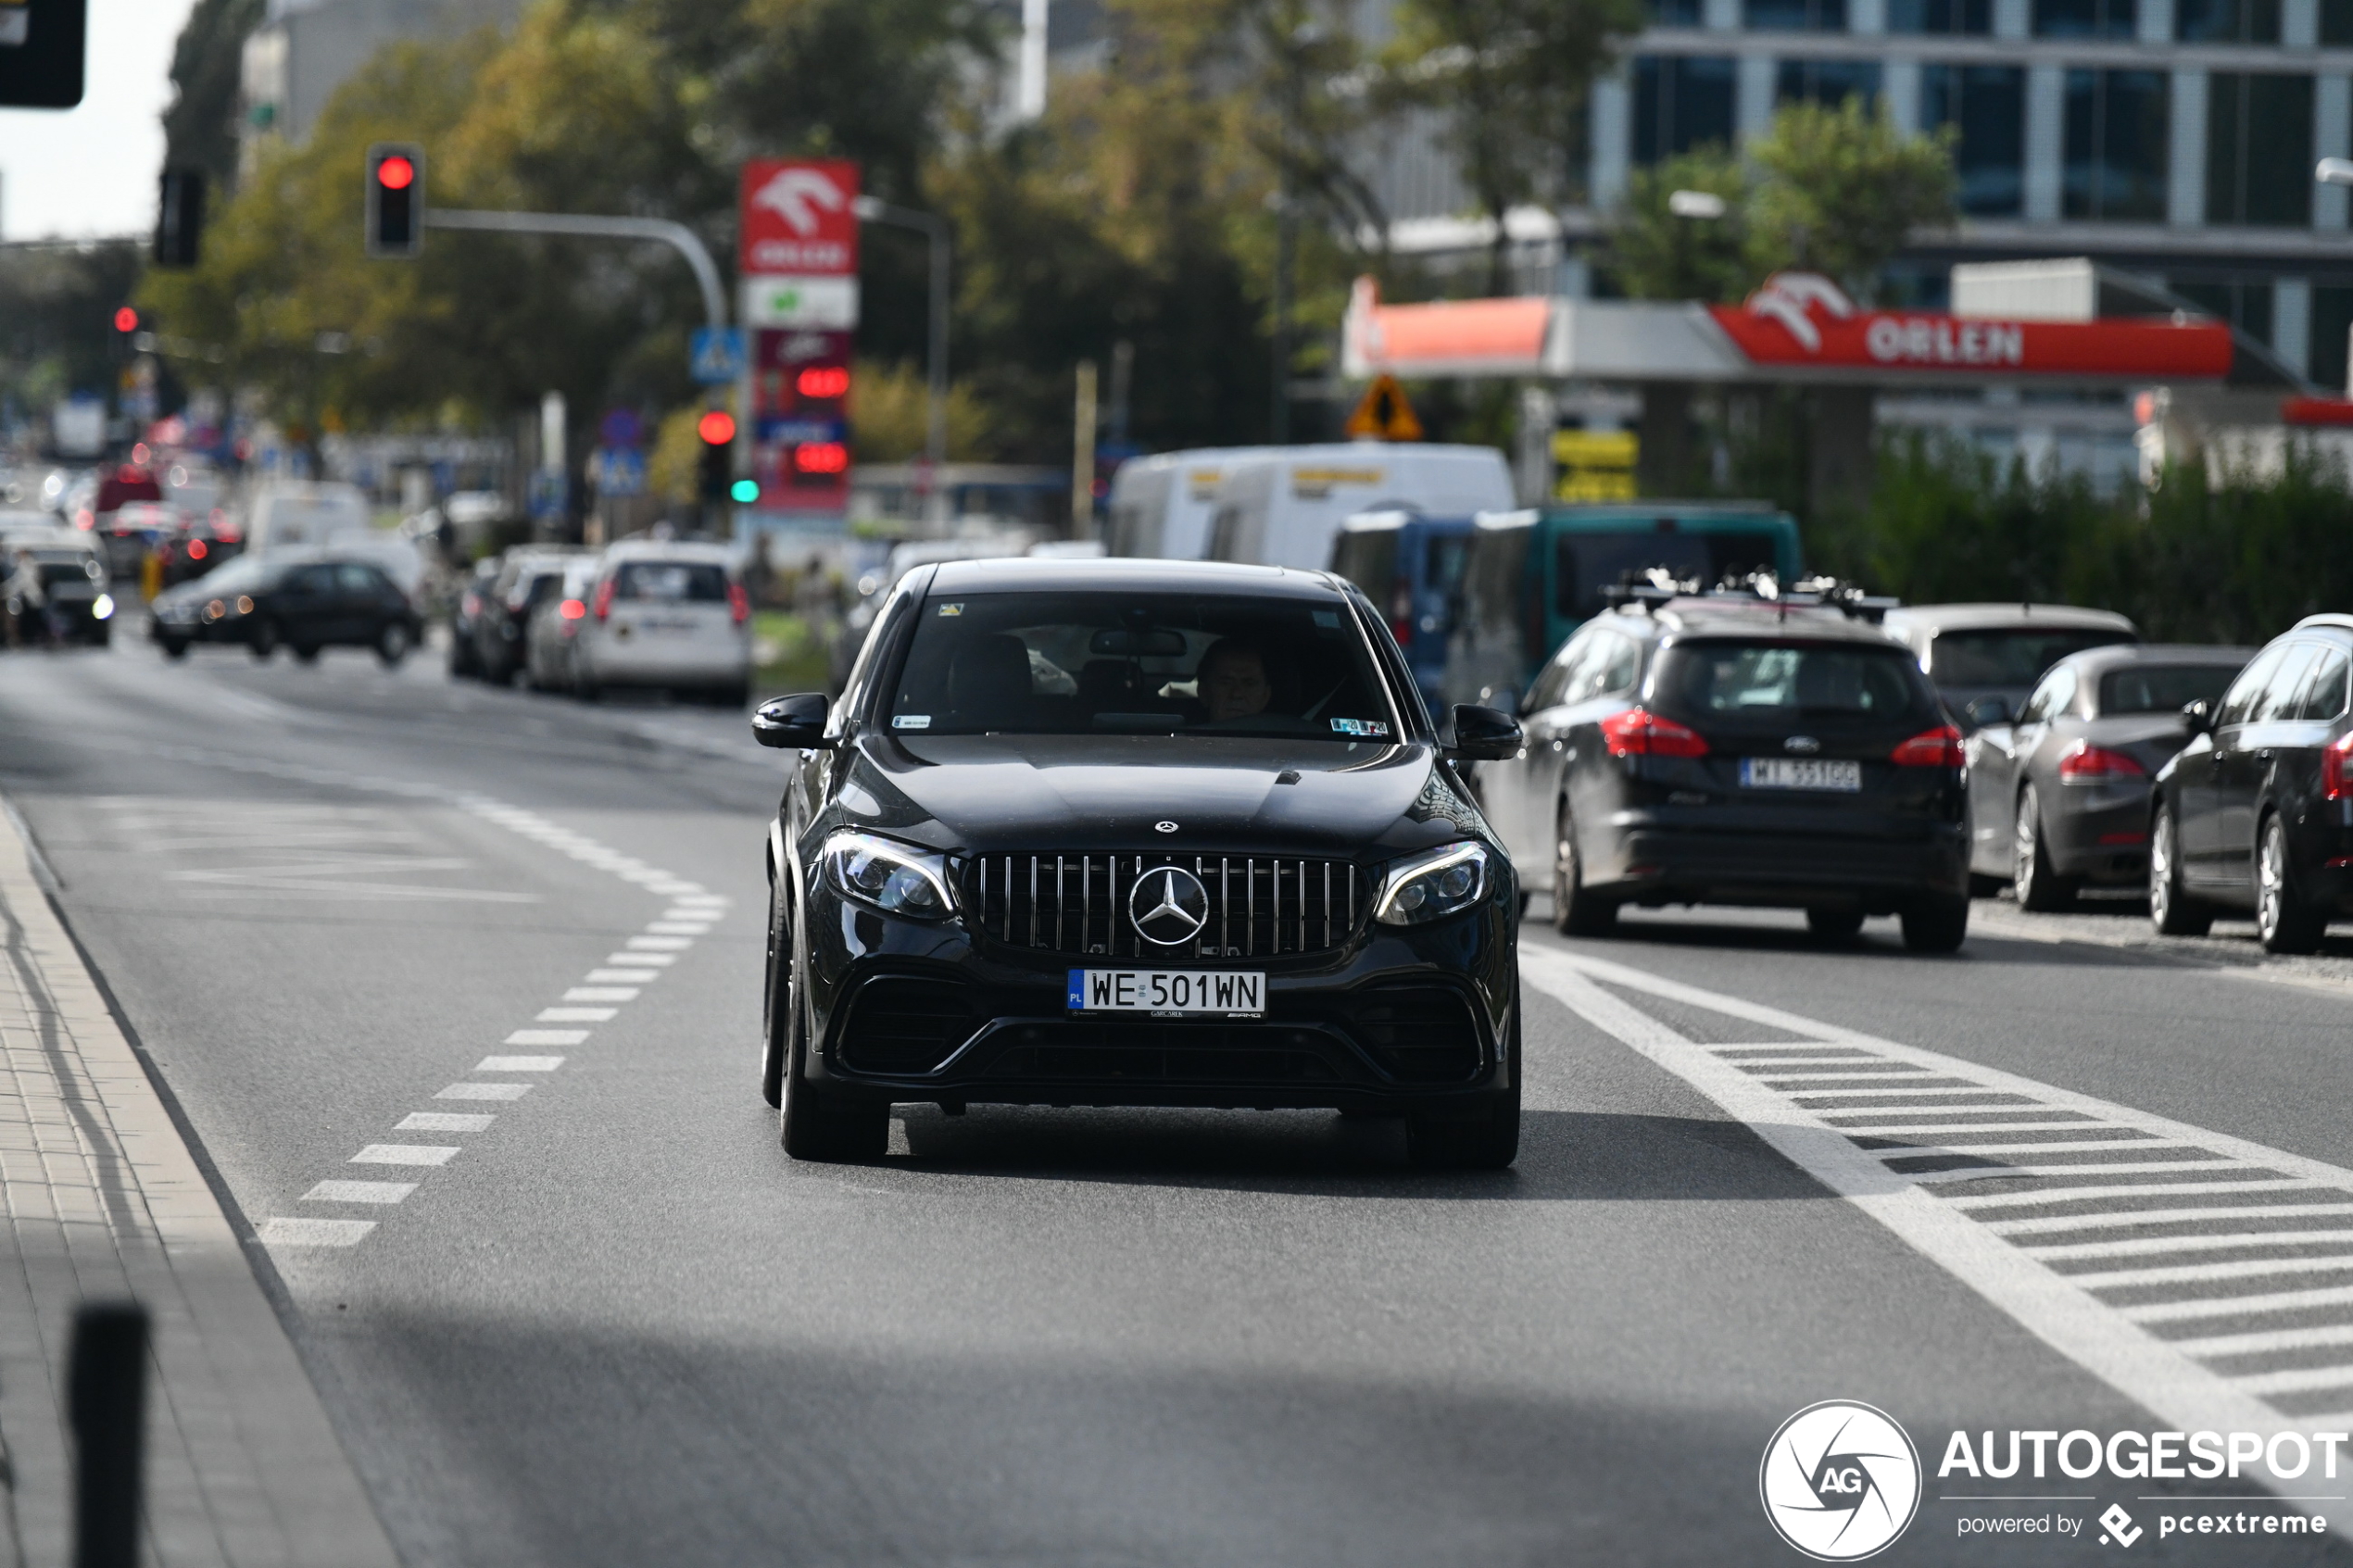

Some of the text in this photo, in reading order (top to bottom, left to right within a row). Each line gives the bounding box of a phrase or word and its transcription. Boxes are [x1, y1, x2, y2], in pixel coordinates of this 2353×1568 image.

[1867, 318, 2023, 365] ORLEN
[1070, 993, 1082, 1003] PL
[1092, 972, 1257, 1008] WE 501WN
